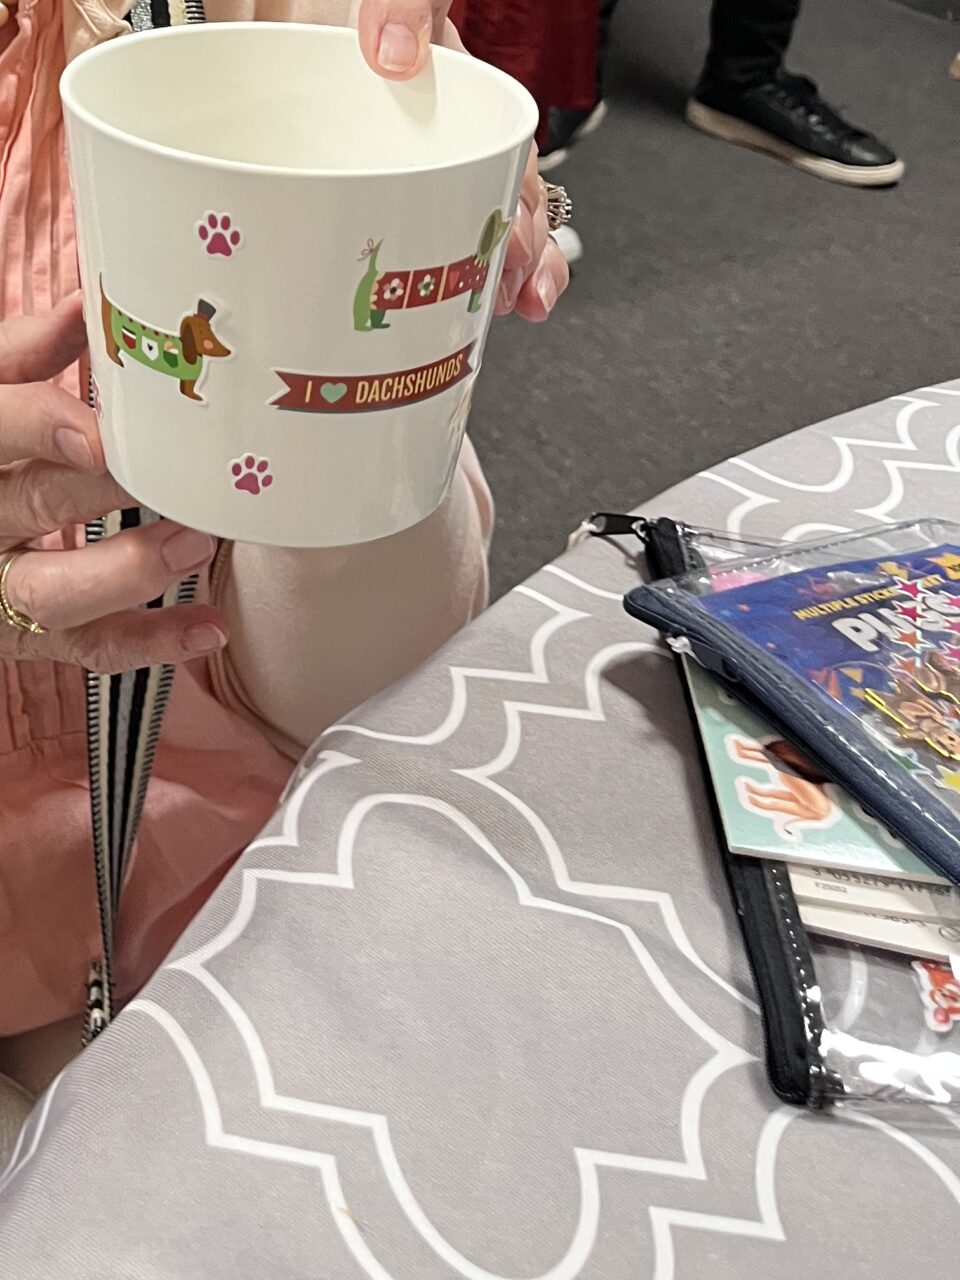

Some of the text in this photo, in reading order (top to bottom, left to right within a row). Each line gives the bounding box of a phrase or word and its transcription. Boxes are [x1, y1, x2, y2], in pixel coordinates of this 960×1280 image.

[304, 354, 463, 404] I DACHSHUNDS
[793, 598, 857, 621] MULTIPLE
